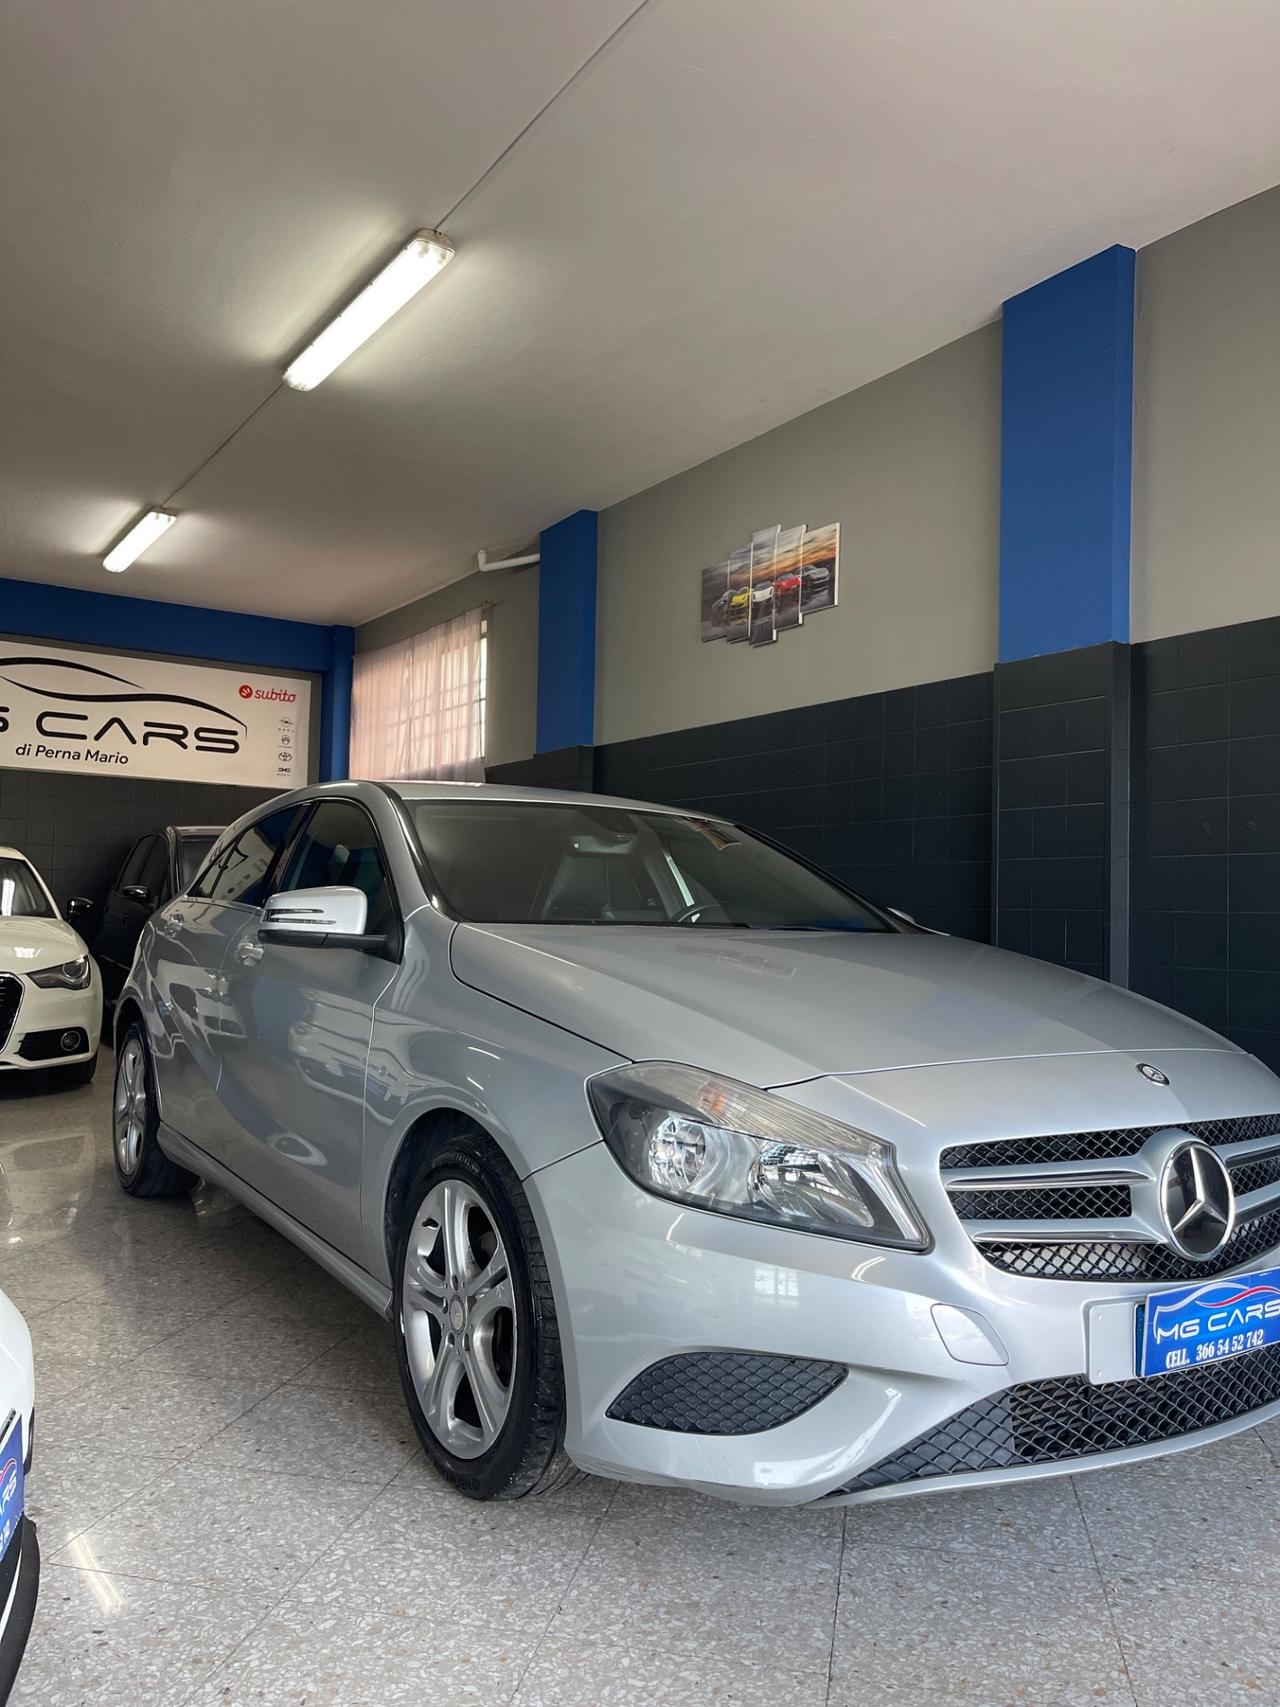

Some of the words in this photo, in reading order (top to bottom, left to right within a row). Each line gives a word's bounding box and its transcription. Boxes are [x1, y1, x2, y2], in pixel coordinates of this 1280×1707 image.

[254, 687, 297, 703] subito
[36, 711, 240, 754] CARS
[15, 743, 32, 757] di
[35, 744, 81, 761] Perna
[85, 749, 129, 765] Mario
[1156, 1318, 1200, 1345] MG
[1166, 1348, 1190, 1369] CELL.
[1196, 1341, 1215, 1361] 366
[1217, 1337, 1230, 1356] 54
[1231, 1333, 1244, 1352] 52
[1246, 1328, 1264, 1348] 742
